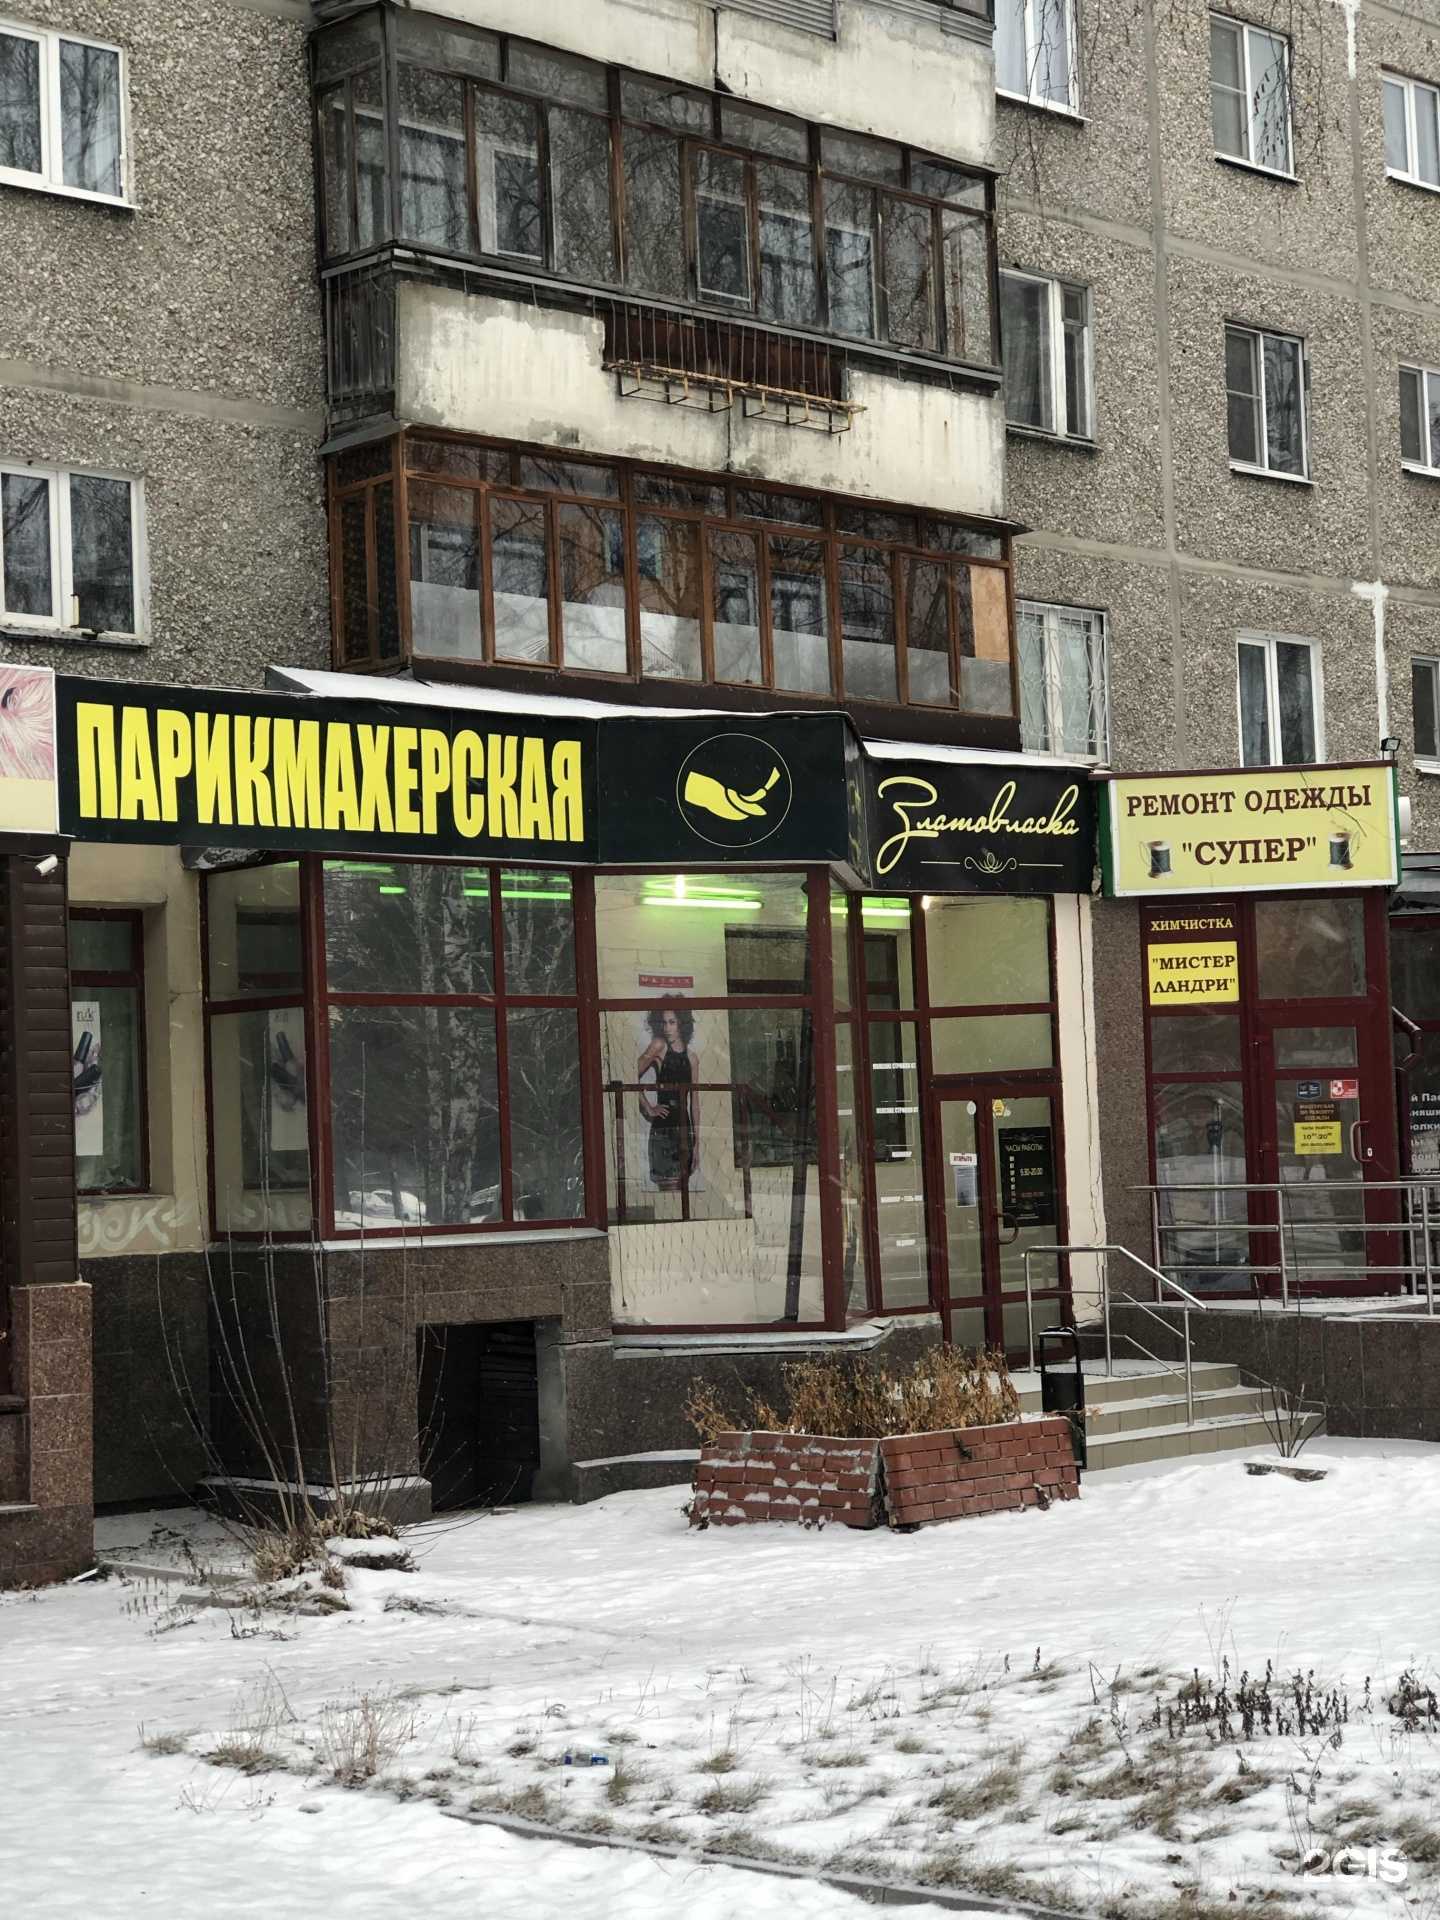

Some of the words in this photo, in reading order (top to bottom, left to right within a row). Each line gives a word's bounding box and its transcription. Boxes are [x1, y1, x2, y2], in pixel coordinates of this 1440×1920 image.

[76, 702, 584, 842] ПАРИКМАХЕРСКАЯ
[1126, 791, 1236, 817] РЕМОНТ
[1244, 785, 1372, 812] ОДЕЖДЫ
[876, 776, 1080, 875] Златовласка
[1182, 836, 1317, 865] "СУПЕР"
[1150, 918, 1234, 931] ХИМЧИСТКА
[1152, 955, 1236, 970] "МИСТЕР
[1153, 978, 1236, 994] ЛАНДРИ"
